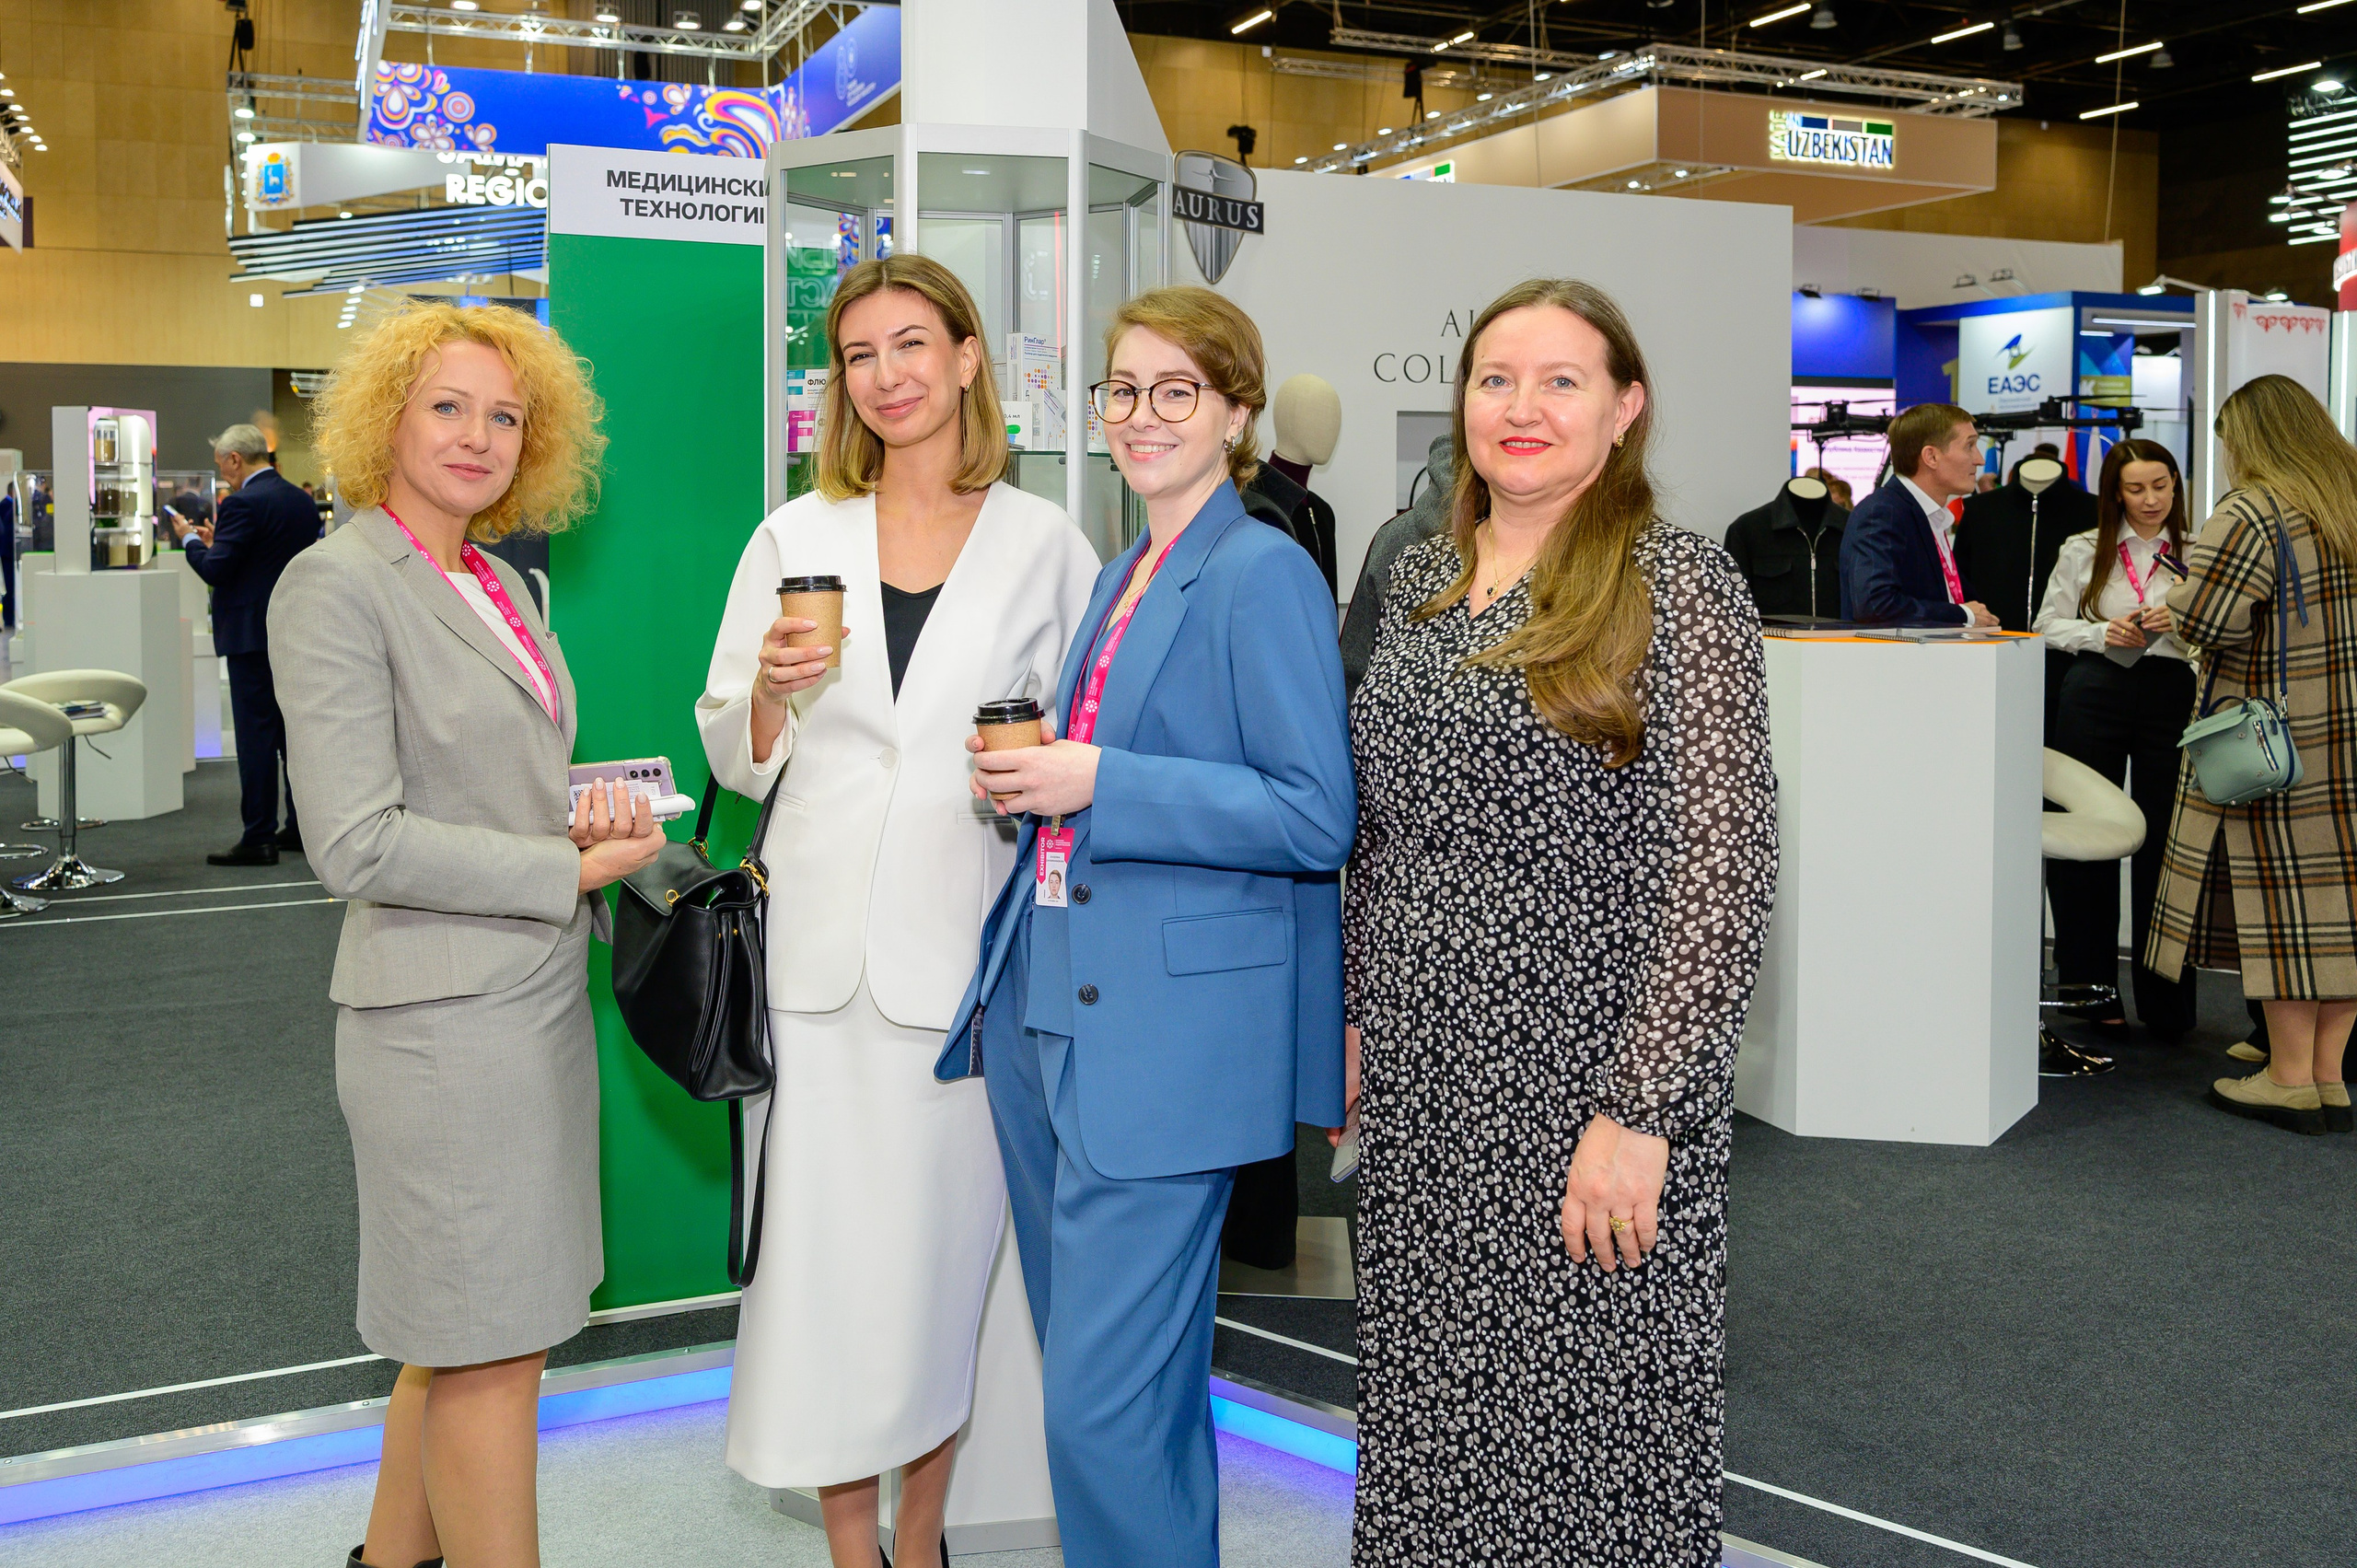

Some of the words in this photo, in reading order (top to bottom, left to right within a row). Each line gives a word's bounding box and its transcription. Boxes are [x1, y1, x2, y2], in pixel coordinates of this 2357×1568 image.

[1787, 130, 1894, 166] UZBEKISTAN
[446, 173, 548, 208] REGIO
[607, 169, 771, 198] МЕДИЦИНСКИ
[1173, 190, 1260, 228] AURUS
[1373, 353, 1455, 385] COL
[1988, 373, 2041, 395] ЕАЭС
